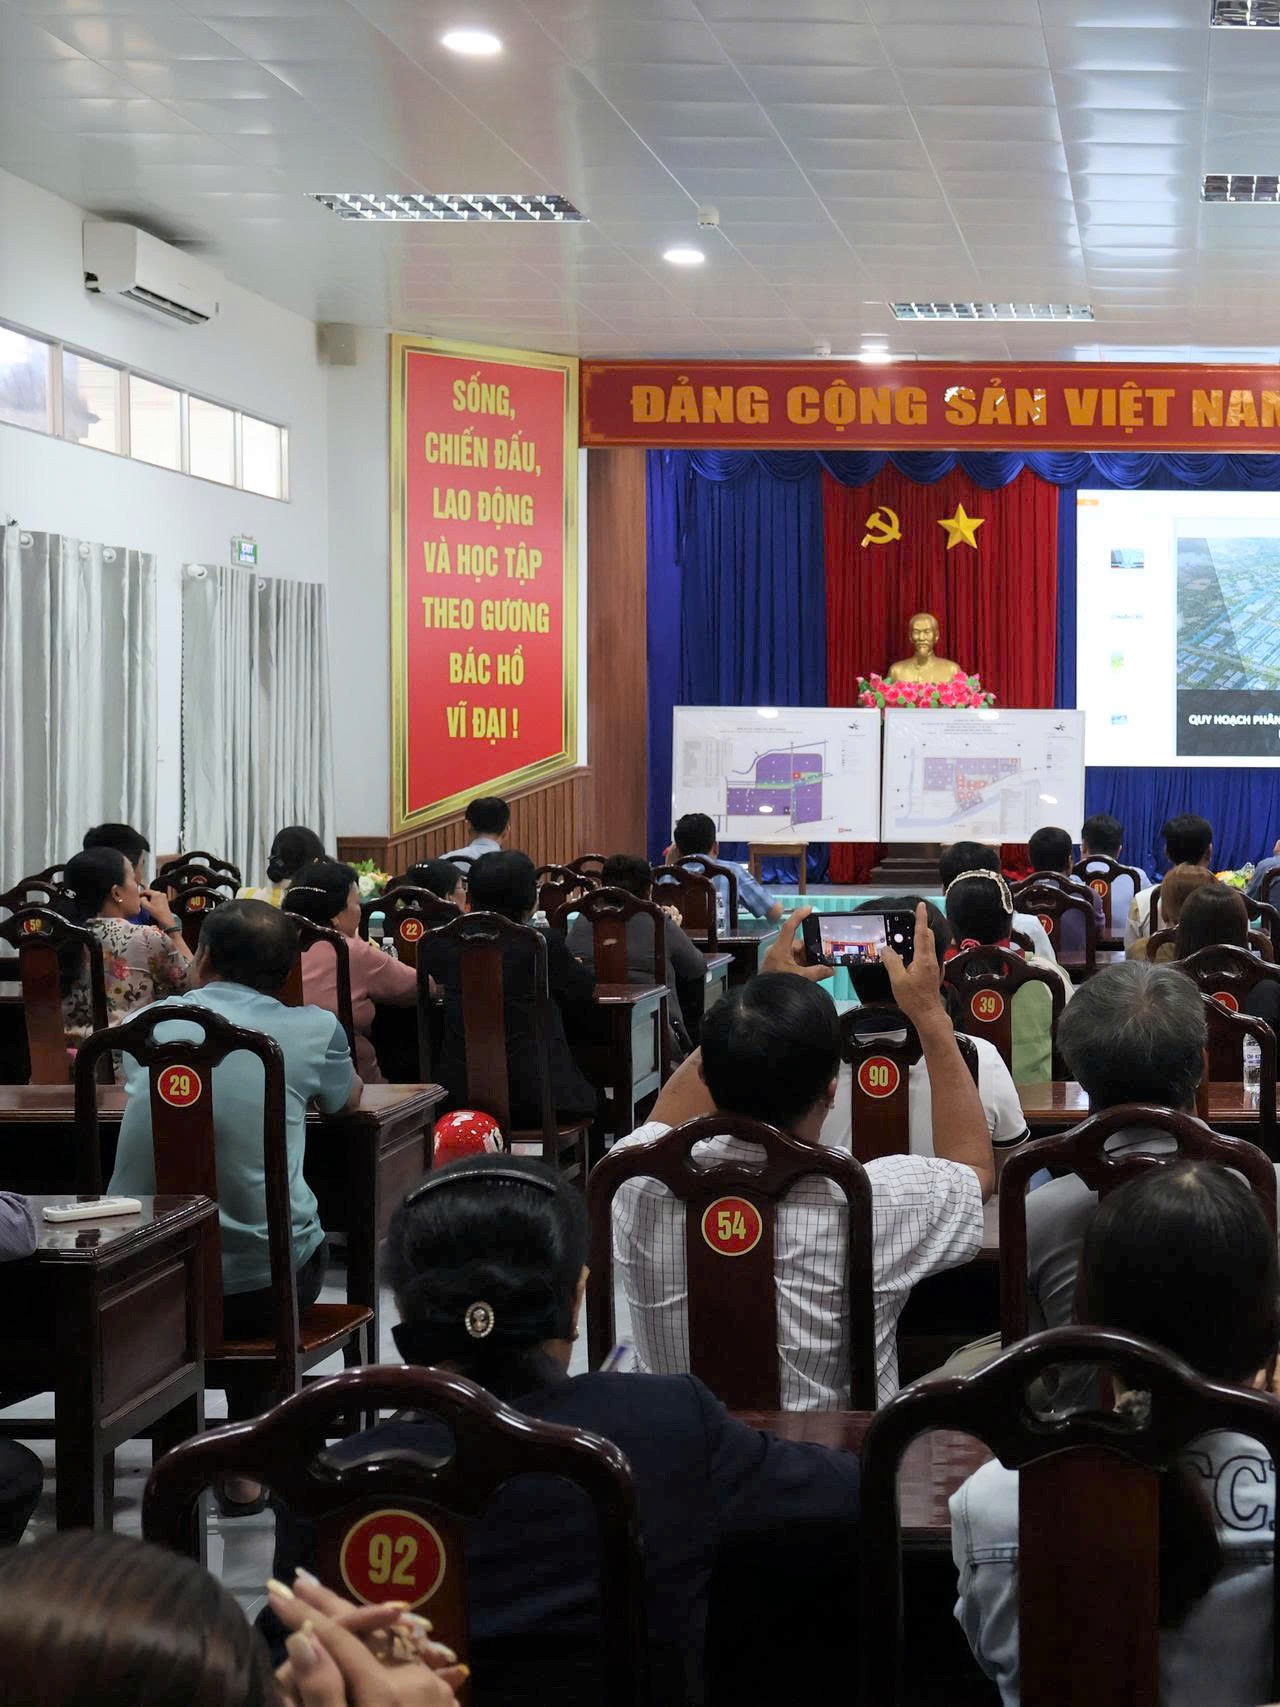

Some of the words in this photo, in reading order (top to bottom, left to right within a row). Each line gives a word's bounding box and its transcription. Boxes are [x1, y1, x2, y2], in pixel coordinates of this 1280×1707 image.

[453, 371, 516, 420] SỐNG,
[631, 376, 769, 424] ĐẢNG
[787, 379, 928, 432] CỘNG
[945, 378, 1047, 426] SẢN
[1064, 381, 1175, 433] VIỆT
[425, 426, 489, 468] CHIẾN
[494, 430, 541, 477] ĐẤU,
[433, 487, 472, 521] LAO
[477, 486, 534, 530] ĐỘNG
[423, 535, 451, 574] VÀ
[457, 544, 499, 583] HỌC
[504, 541, 543, 586] TẬP
[422, 596, 474, 630] THEO
[481, 598, 549, 633] GƯƠNG
[450, 646, 491, 685] BÁC
[497, 644, 524, 685] HỒ
[446, 700, 467, 738] VĨ
[472, 707, 507, 745] ĐẠI
[1188, 715, 1213, 726] QUY
[1214, 715, 1251, 727] HOẠCH
[406, 923, 419, 936] 22
[980, 997, 996, 1014] 39
[169, 1074, 191, 1097] 29
[868, 1066, 889, 1088] 90
[717, 1211, 746, 1241] 54
[368, 1534, 417, 1585] 92
